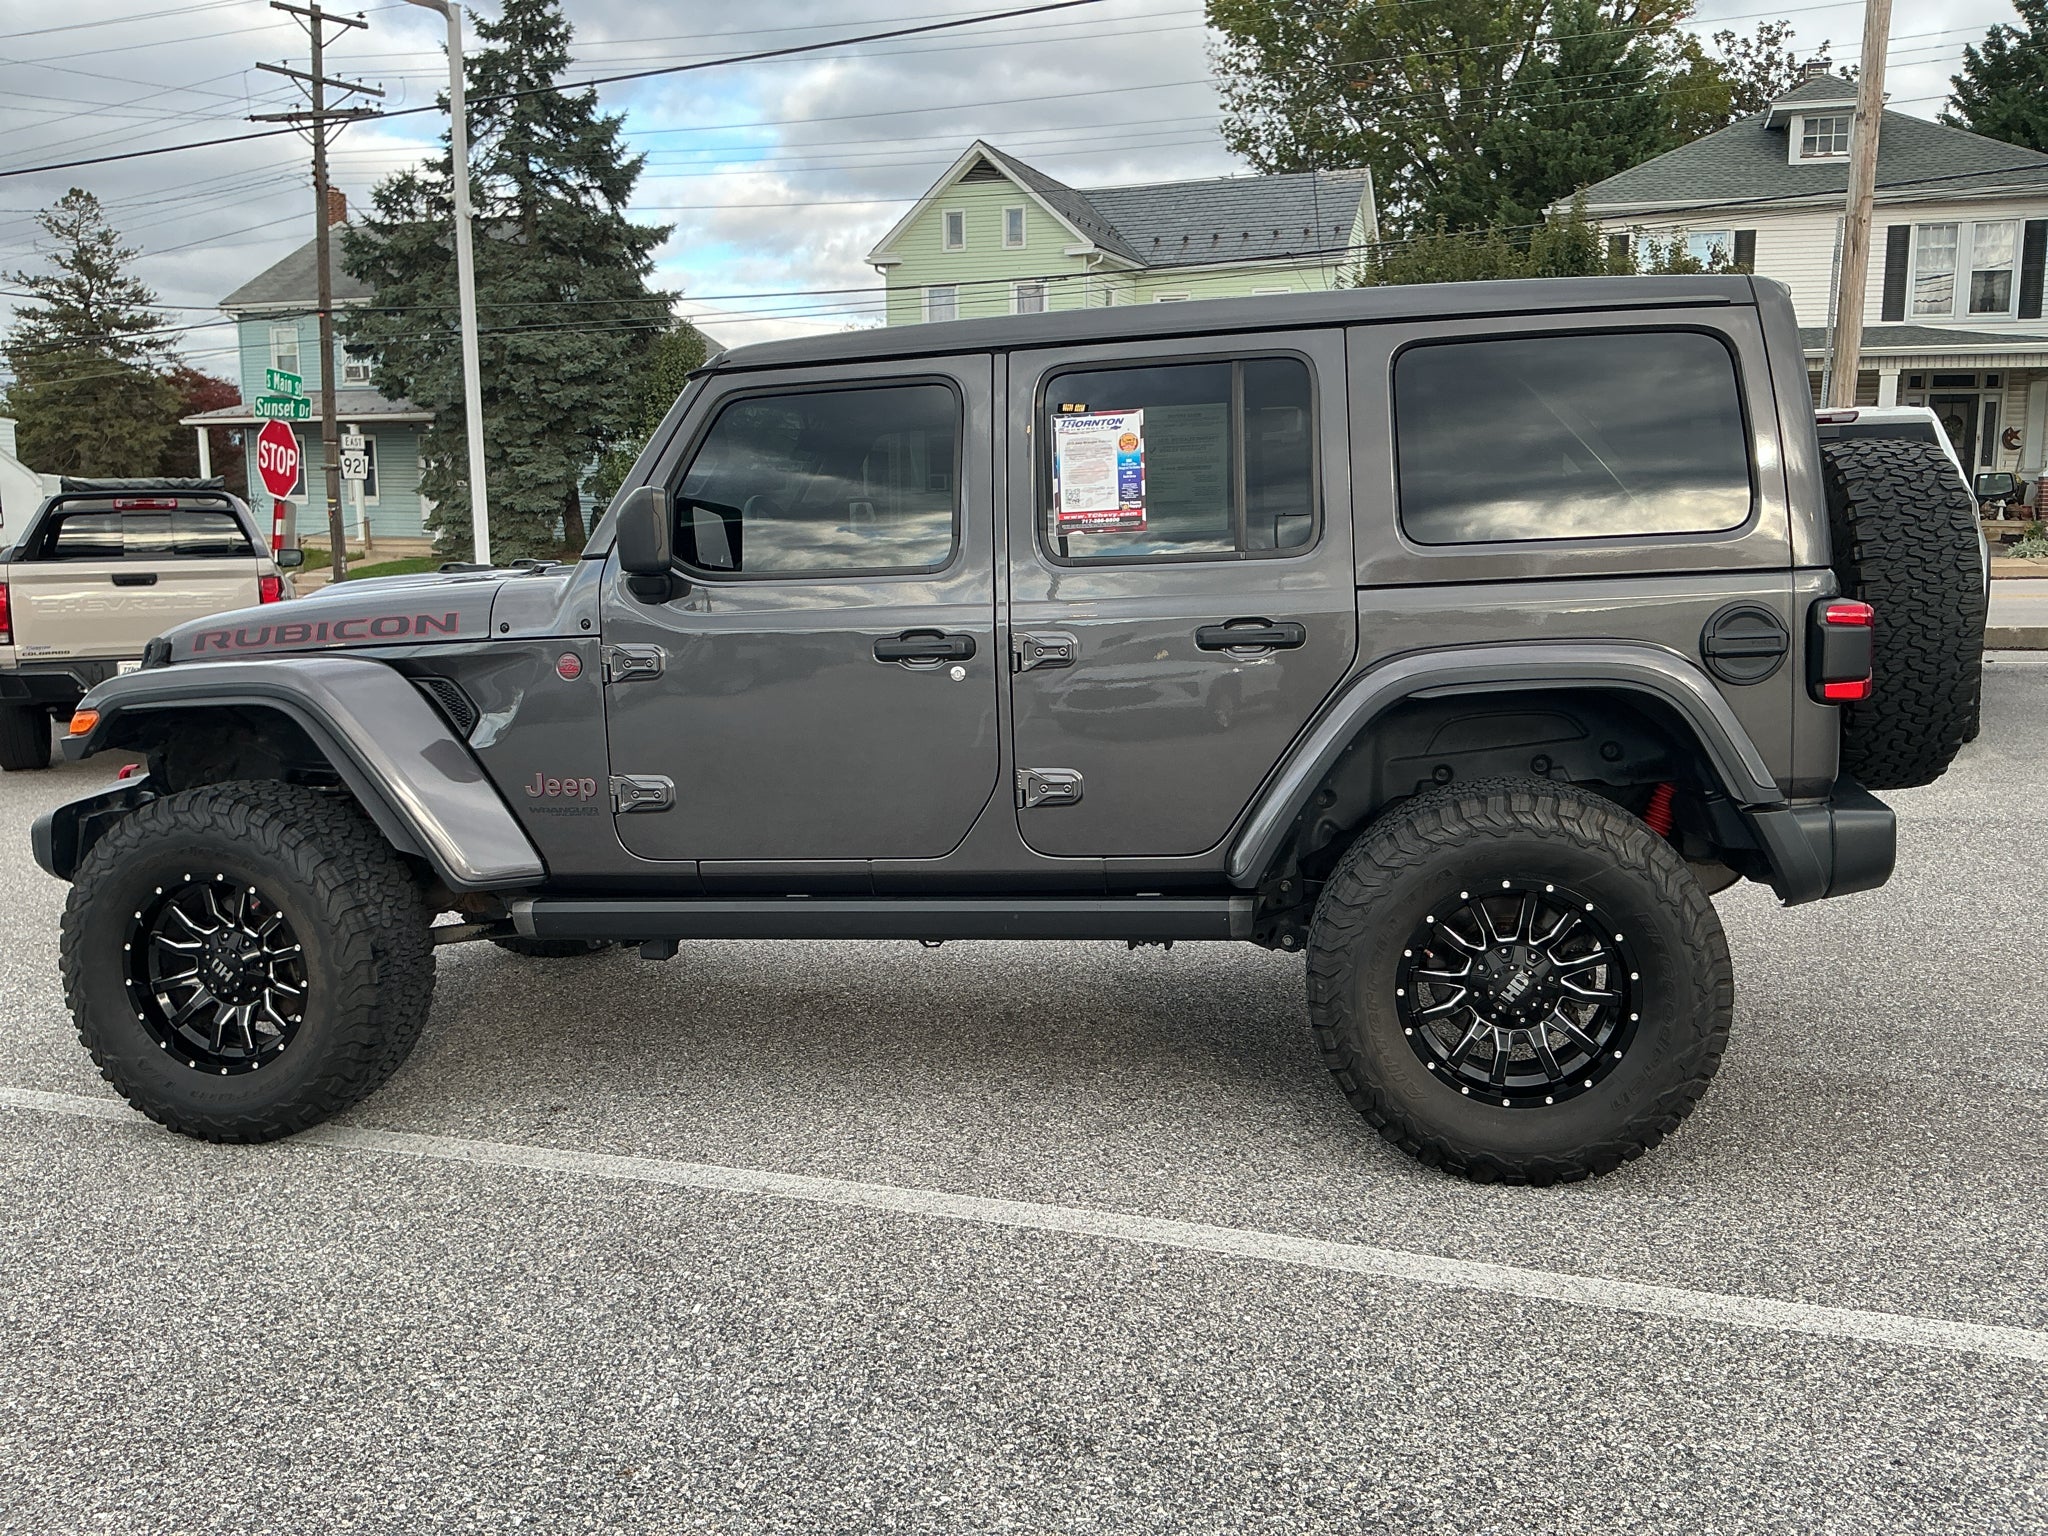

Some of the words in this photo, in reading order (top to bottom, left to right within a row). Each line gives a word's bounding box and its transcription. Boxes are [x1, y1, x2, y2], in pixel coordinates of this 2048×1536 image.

[274, 372, 292, 393] Main
[256, 398, 295, 417] Sunset
[300, 406, 310, 417] Dr
[1061, 417, 1125, 428] THORNTON
[345, 436, 362, 446] EAST
[260, 439, 296, 477] STOP
[343, 457, 367, 474] 921
[192, 611, 460, 651] RUBICON
[524, 773, 598, 801] Jeep
[528, 806, 600, 815] WRANGLER
